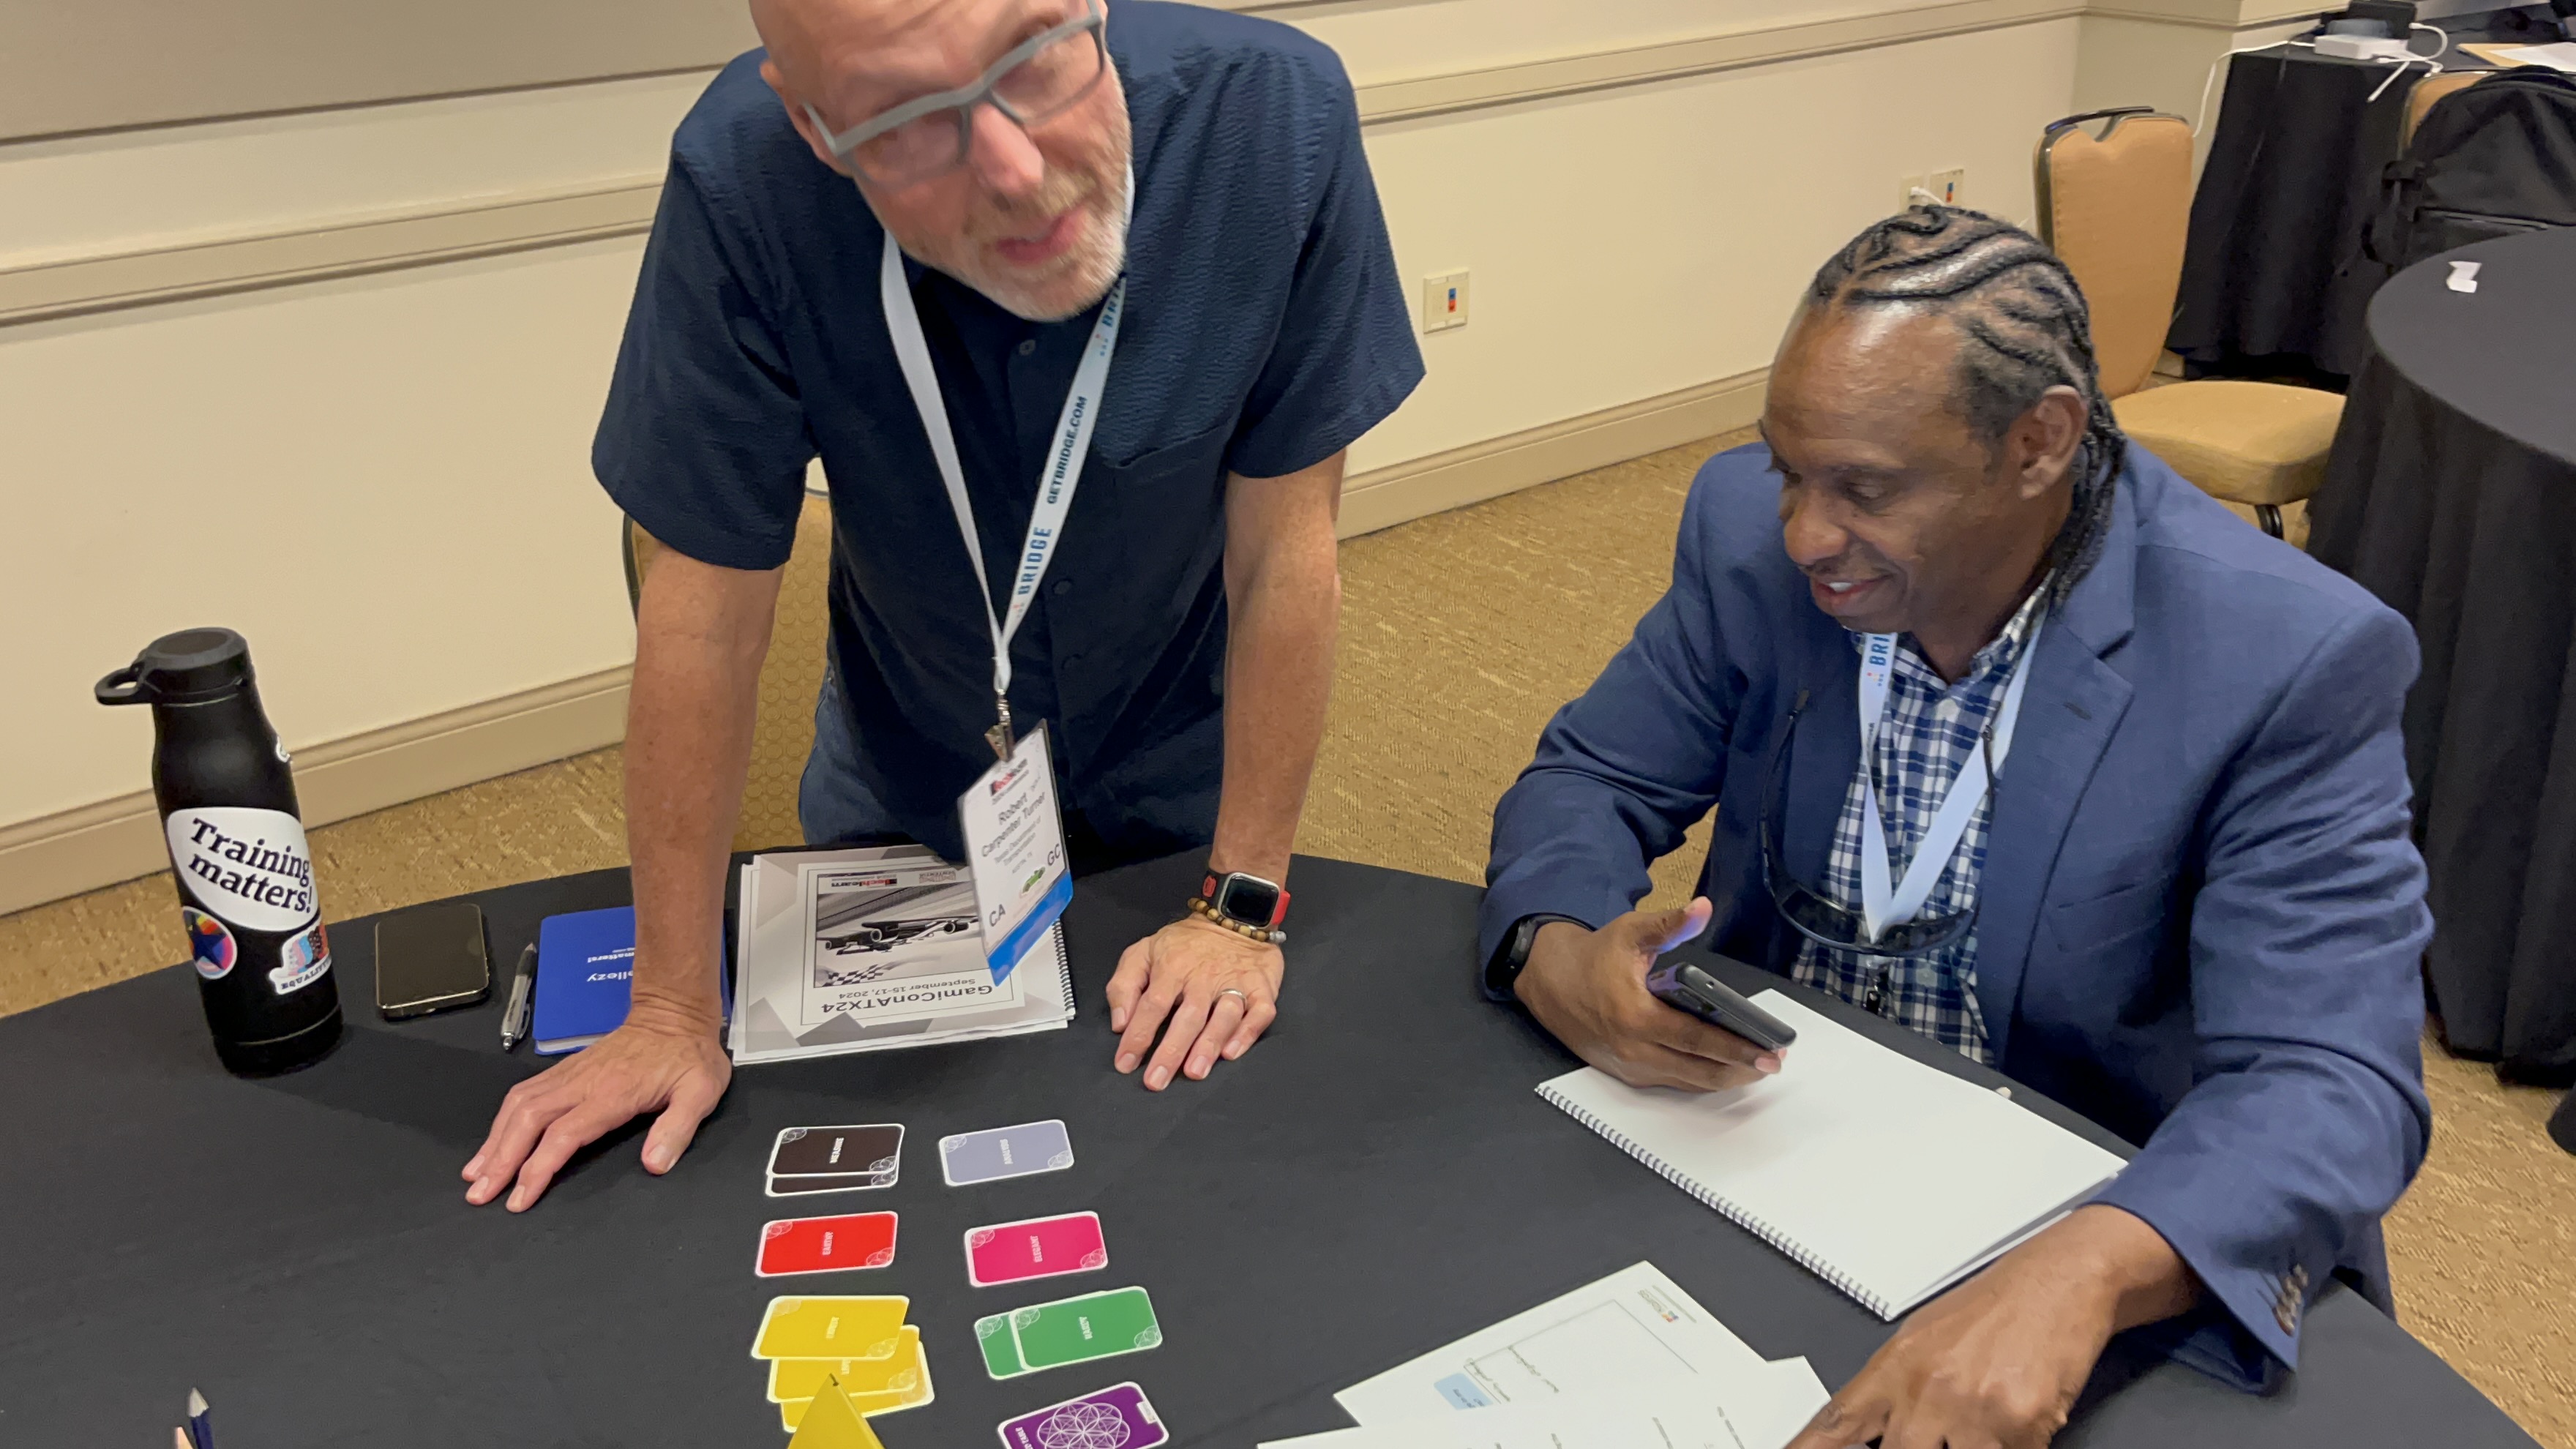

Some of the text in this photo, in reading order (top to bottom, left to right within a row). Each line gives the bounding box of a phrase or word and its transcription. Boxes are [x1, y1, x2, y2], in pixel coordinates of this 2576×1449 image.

[1046, 396, 1087, 505] GETBRIDGE.COM
[1017, 526, 1052, 596] BRIDGE
[981, 792, 1045, 858] Carpenter Turner
[998, 792, 1027, 825] Robert
[191, 817, 310, 888] Training
[1046, 843, 1061, 866] GC
[188, 853, 312, 913] matters!
[989, 904, 1006, 927] CA
[821, 985, 994, 1014] GamiConATX24
[839, 978, 976, 1000] September 15-17, 2024
